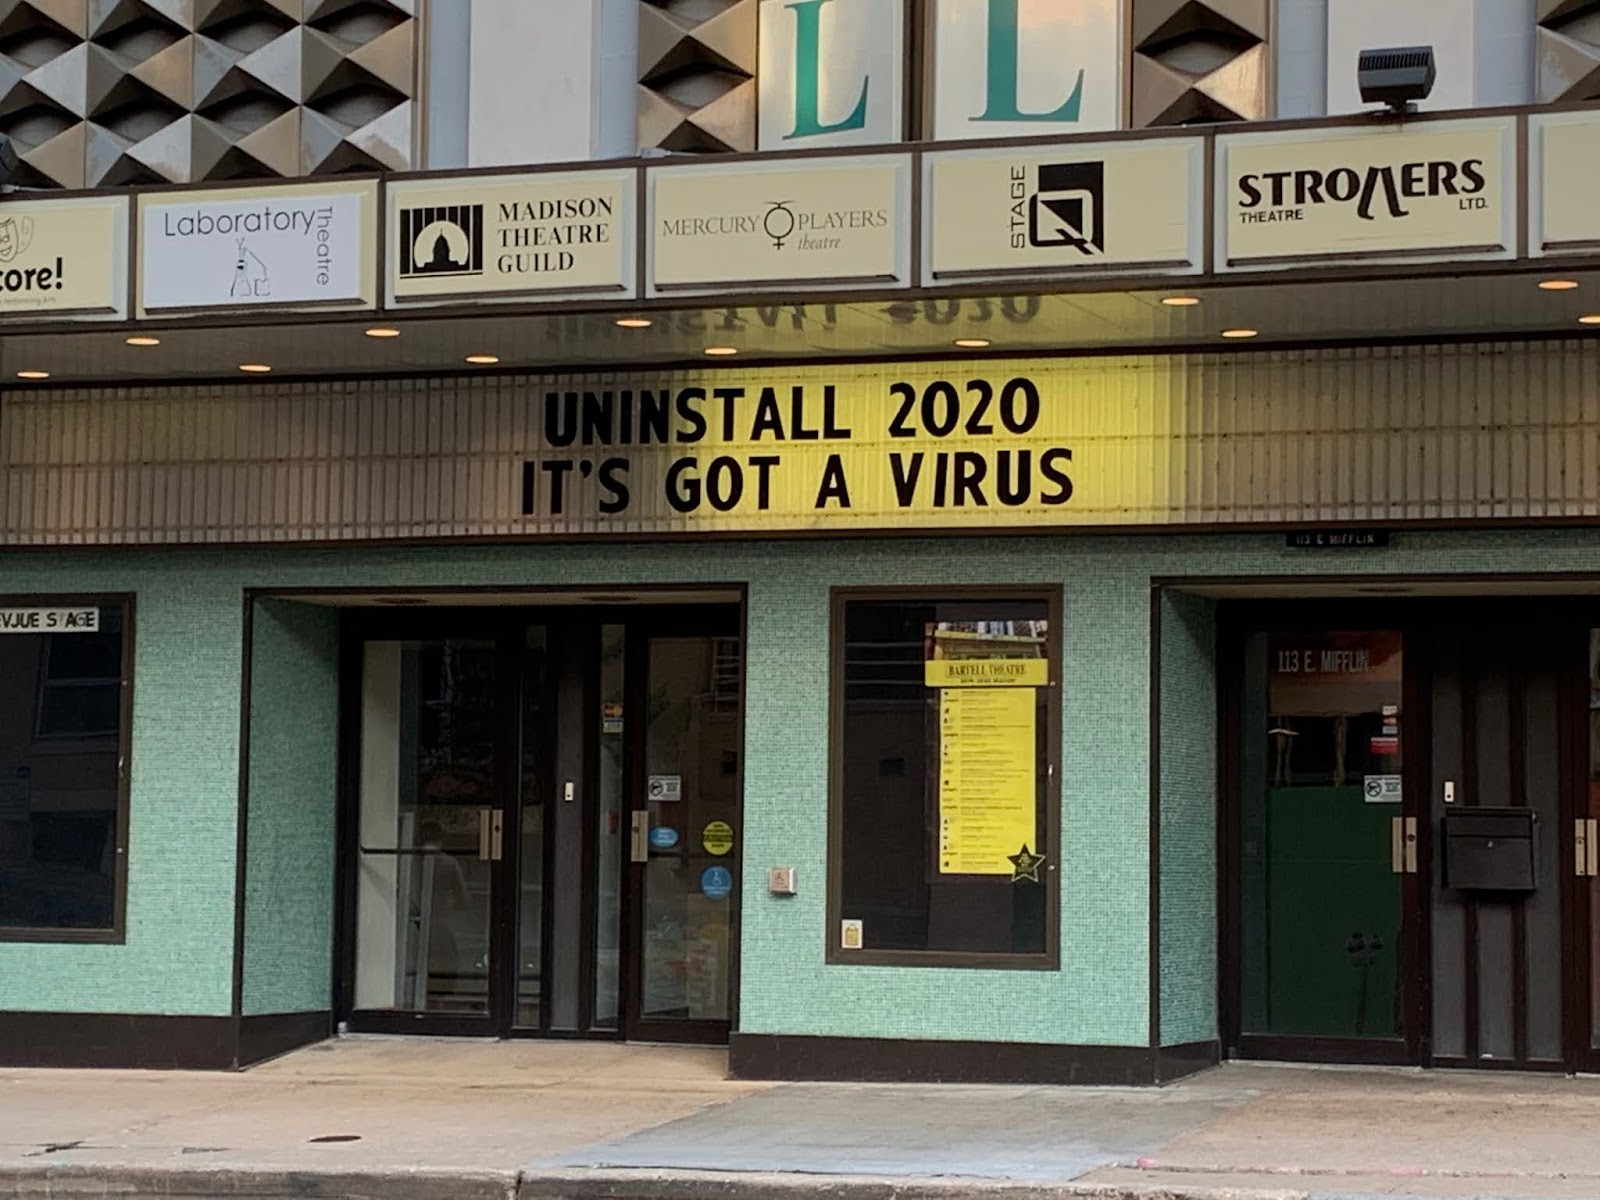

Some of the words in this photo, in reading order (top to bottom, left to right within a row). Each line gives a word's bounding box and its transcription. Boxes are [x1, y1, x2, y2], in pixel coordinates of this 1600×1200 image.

[498, 197, 612, 222] MADISON
[1011, 166, 1025, 249] STAGE
[1239, 208, 1304, 224] THEATRE
[1459, 197, 1488, 211] LTD.
[164, 206, 316, 237] Laboratory
[663, 216, 761, 236] MERCURY
[798, 209, 888, 231] PLAYERS
[316, 206, 333, 286] Theatre
[498, 223, 609, 248] THEATRE
[798, 233, 841, 250] theatre
[498, 251, 574, 274] GUILD
[544, 385, 851, 447] UNINSTALL
[888, 377, 1040, 437] 2020
[522, 457, 630, 515] IT'S
[665, 455, 781, 513] GOT
[815, 454, 851, 509] A
[889, 447, 1074, 507] VIRUS
[0, 611, 40, 629] VJUE
[47, 611, 95, 628] SAGE
[1278, 650, 1299, 673] 113
